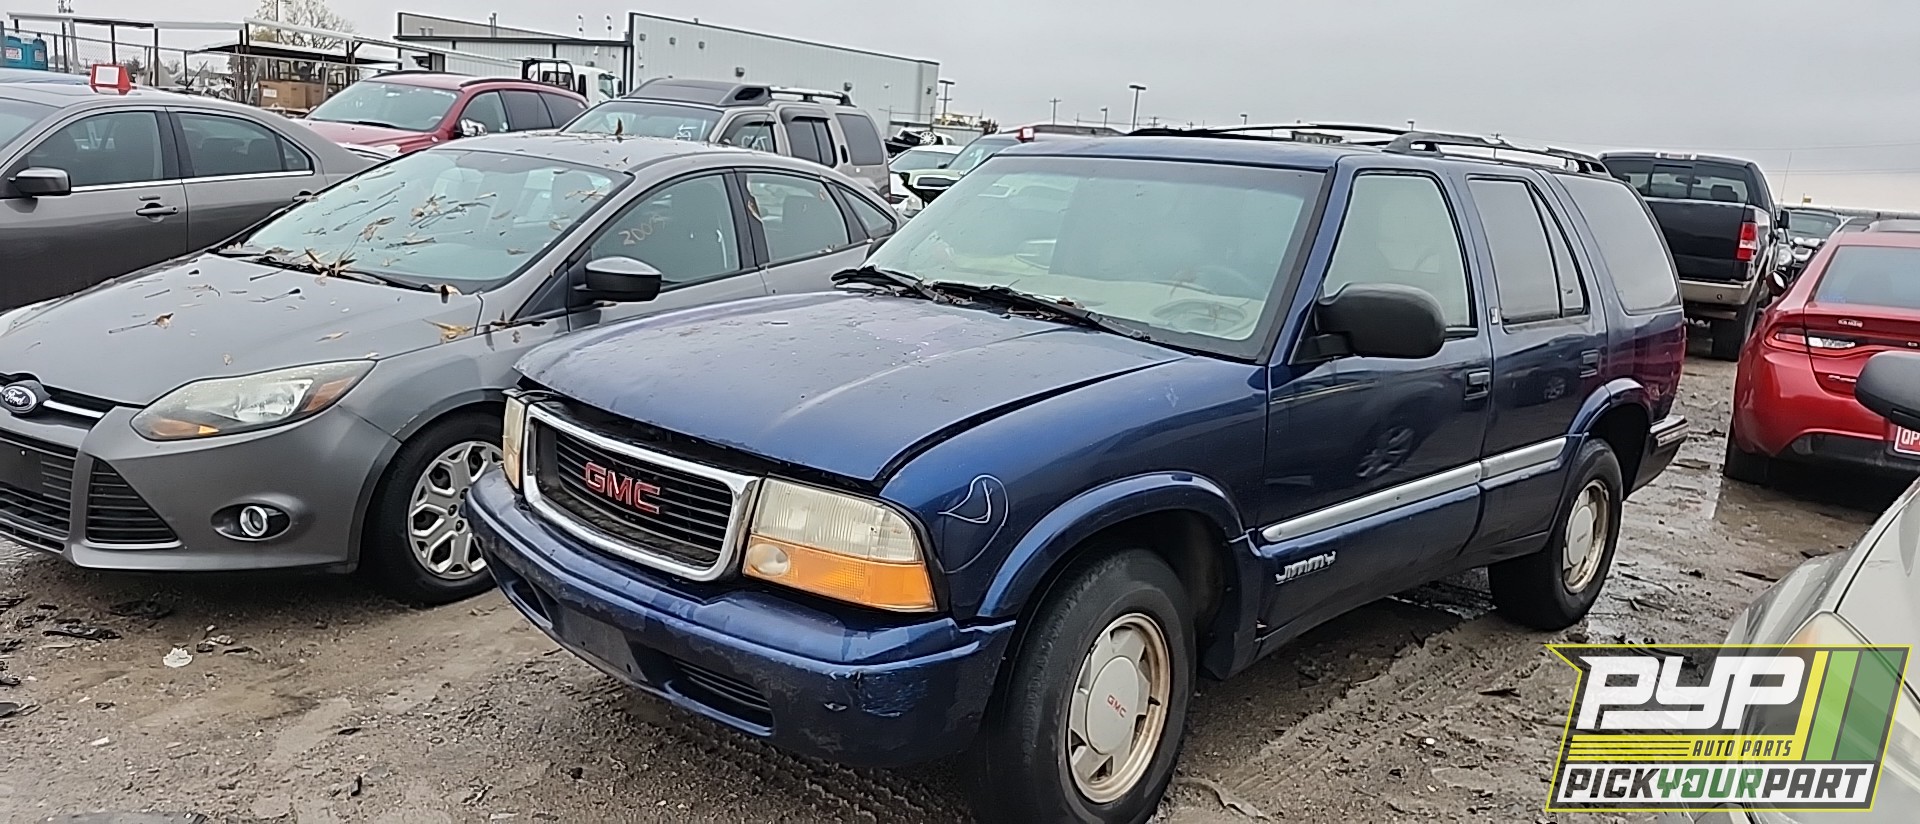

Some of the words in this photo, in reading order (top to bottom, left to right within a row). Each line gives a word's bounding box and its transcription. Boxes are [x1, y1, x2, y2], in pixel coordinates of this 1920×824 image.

[5, 388, 26, 405] Ford
[585, 461, 661, 514] GMC
[1107, 694, 1127, 718] GMC
